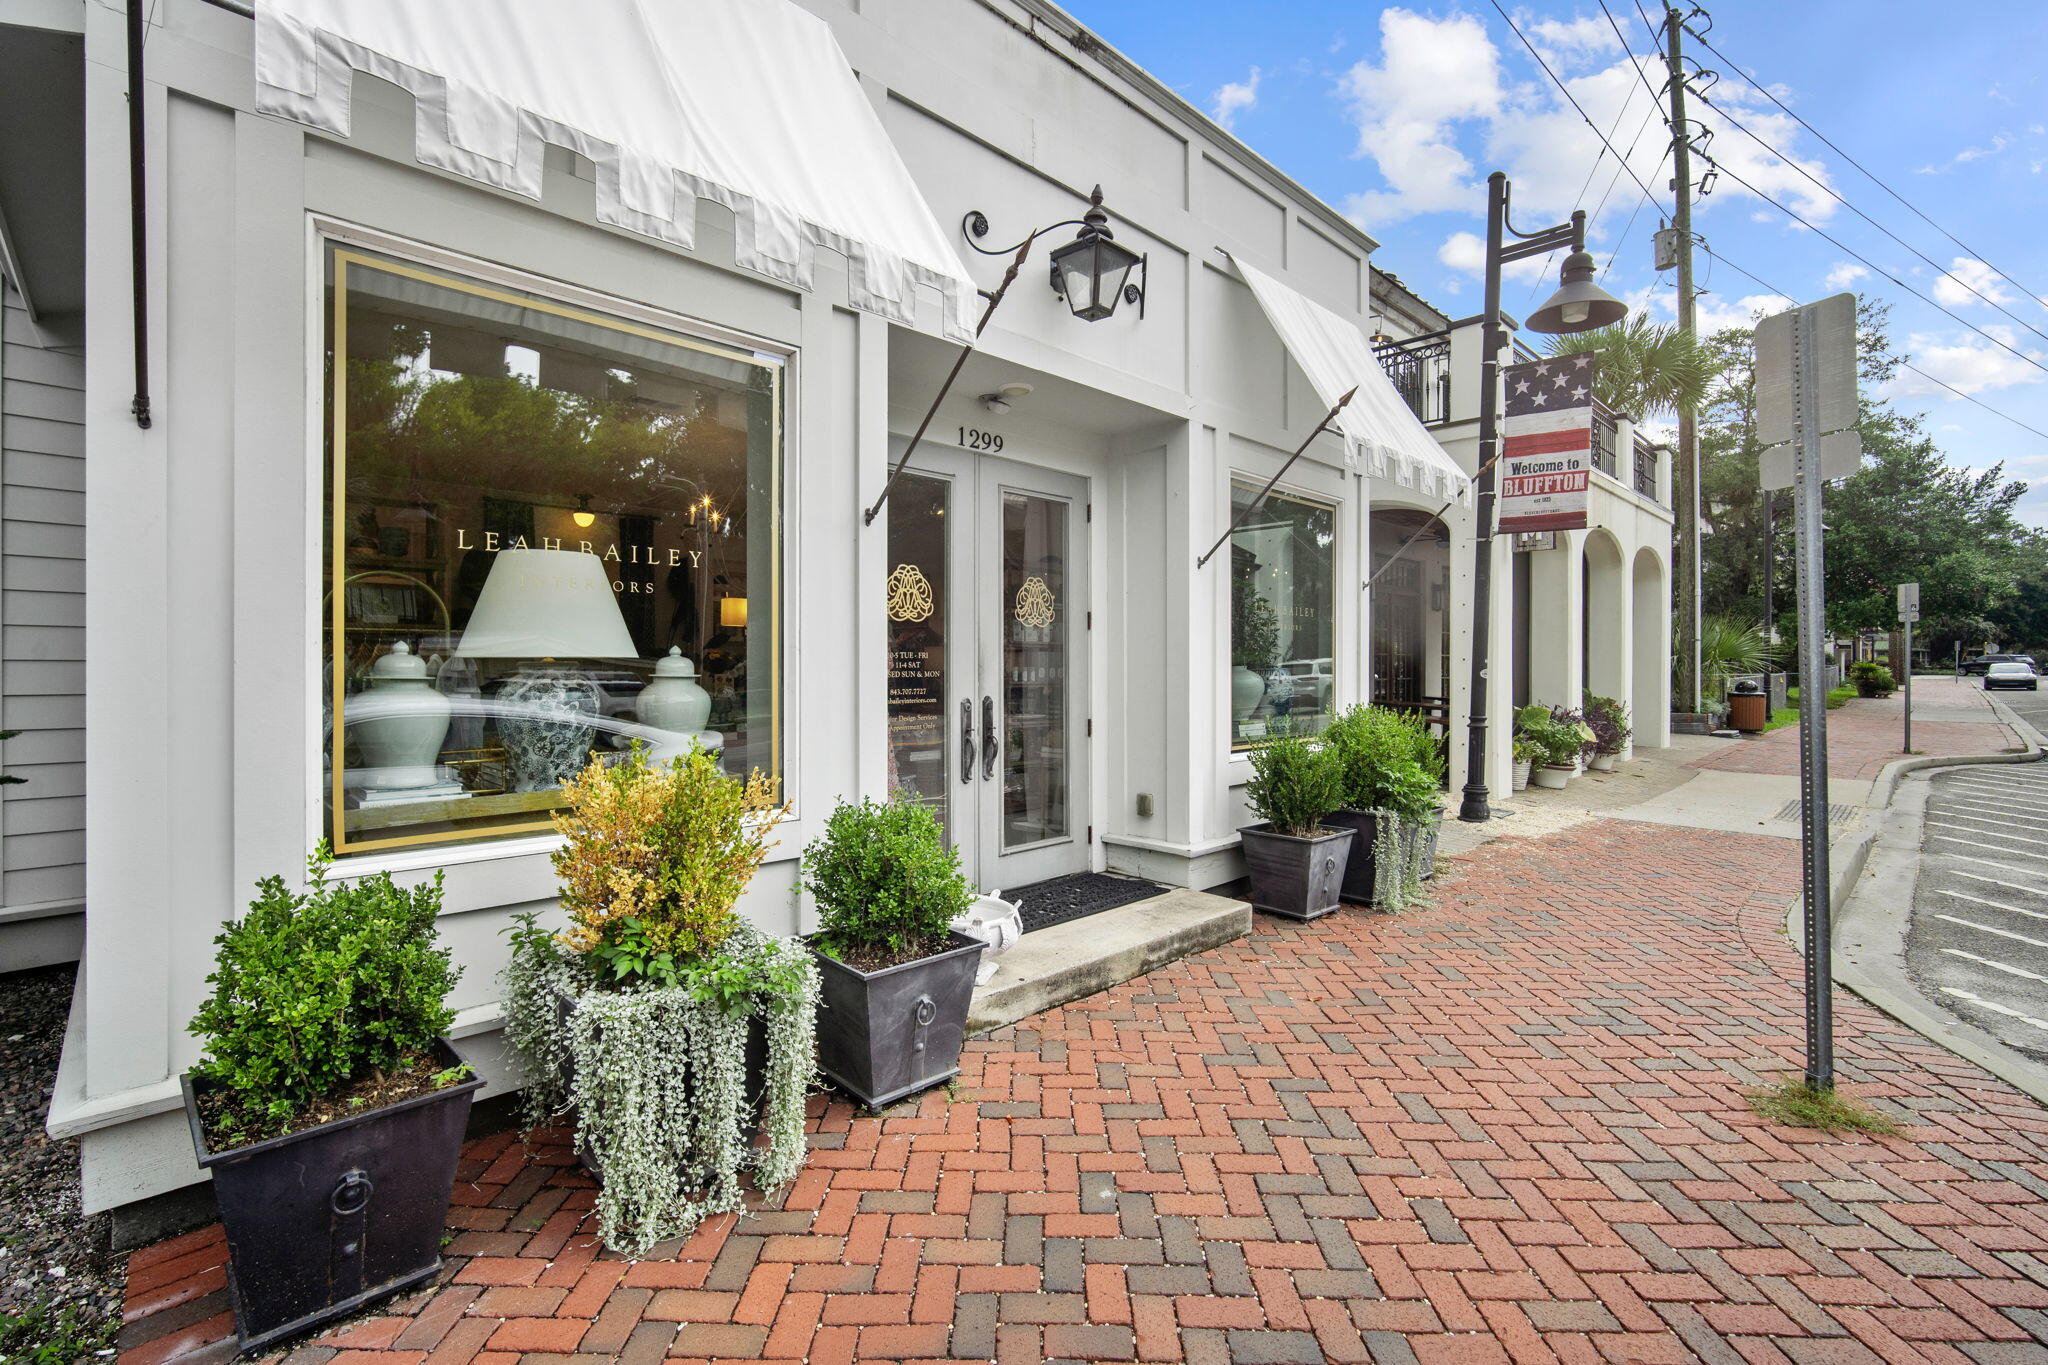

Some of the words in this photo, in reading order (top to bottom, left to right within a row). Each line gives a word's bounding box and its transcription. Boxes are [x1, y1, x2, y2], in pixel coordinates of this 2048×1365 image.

[958, 427, 1003, 453] 1299
[1511, 461, 1563, 475] Welcome
[1567, 459, 1579, 470] to
[1504, 473, 1586, 496] BLUFFTON
[457, 529, 561, 557] LEAH
[579, 541, 702, 568] BAILEY
